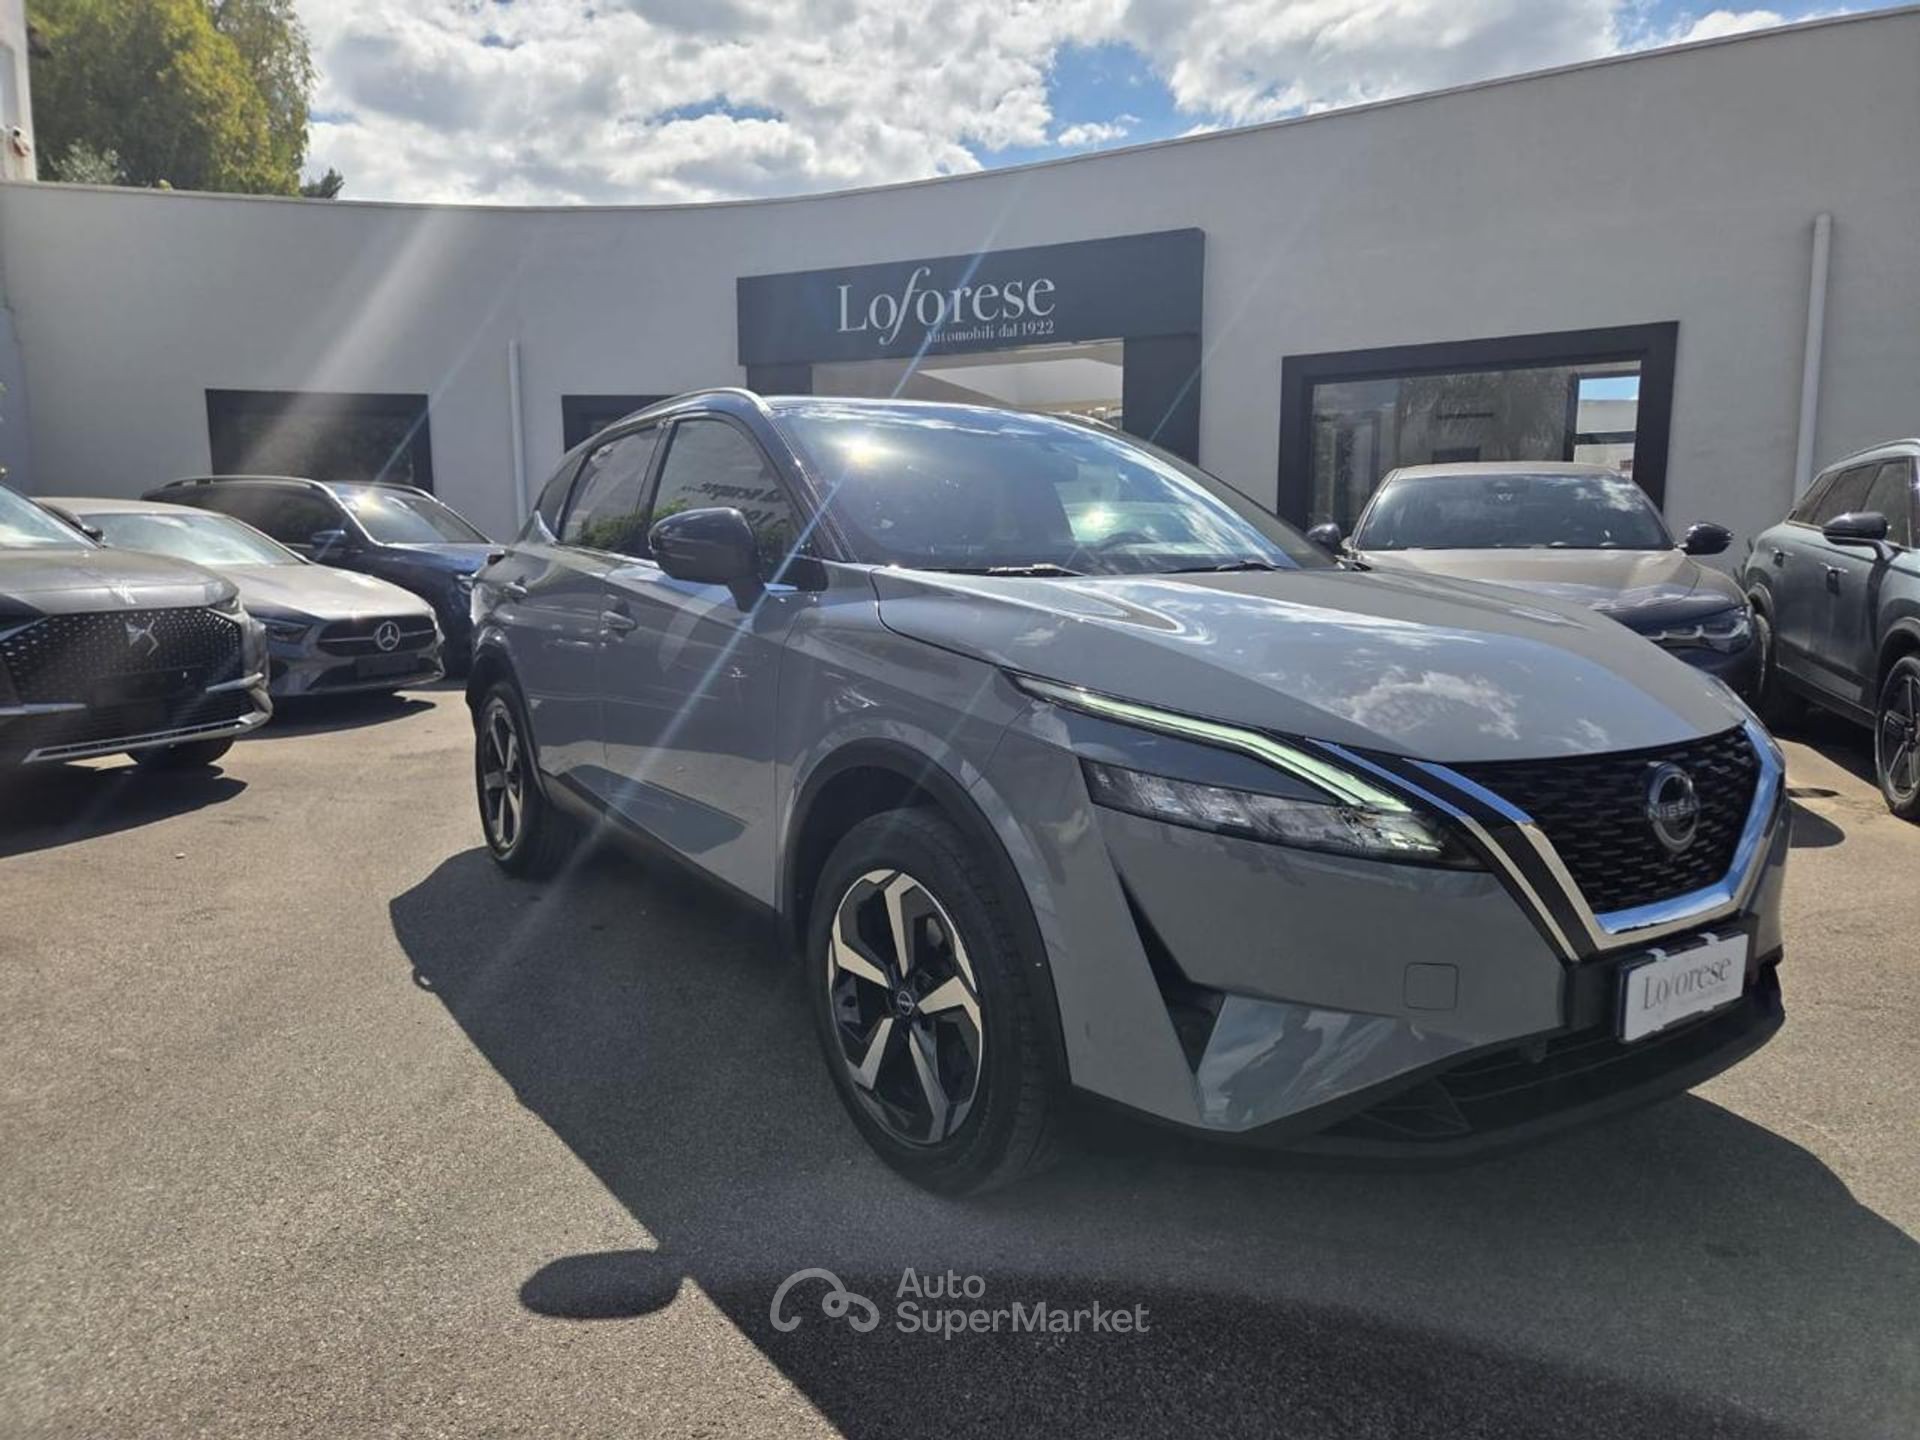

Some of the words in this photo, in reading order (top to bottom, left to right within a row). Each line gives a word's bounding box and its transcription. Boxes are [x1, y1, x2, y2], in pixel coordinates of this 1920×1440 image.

[836, 266, 1056, 345] Loforese
[998, 323, 1017, 338] dal
[1022, 319, 1054, 336] 1922
